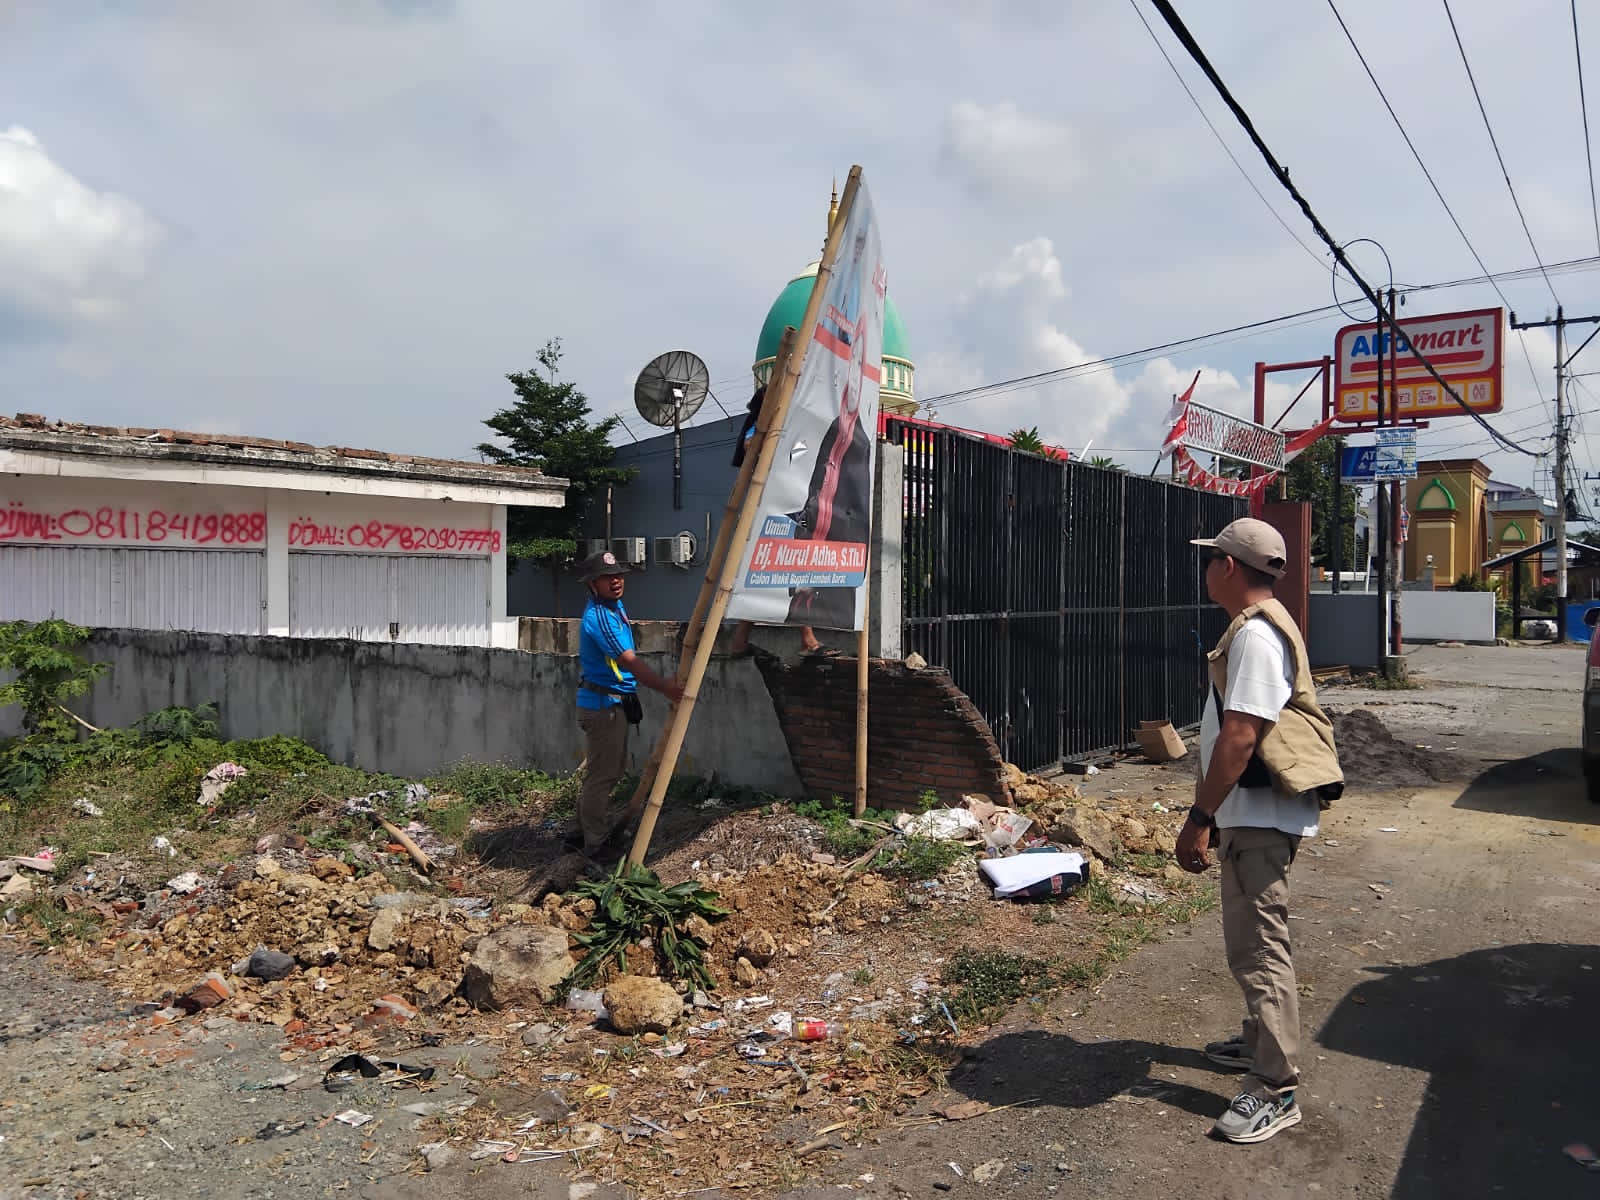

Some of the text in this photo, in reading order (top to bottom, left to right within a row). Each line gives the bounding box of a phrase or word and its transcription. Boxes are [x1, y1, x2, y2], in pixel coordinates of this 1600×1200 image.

[764, 519, 791, 536] Ummi
[753, 541, 773, 570] Hj.
[774, 544, 810, 567] Nurul
[809, 545, 839, 571] Adha,
[750, 573, 770, 585] Calon
[771, 573, 789, 585] Wakil
